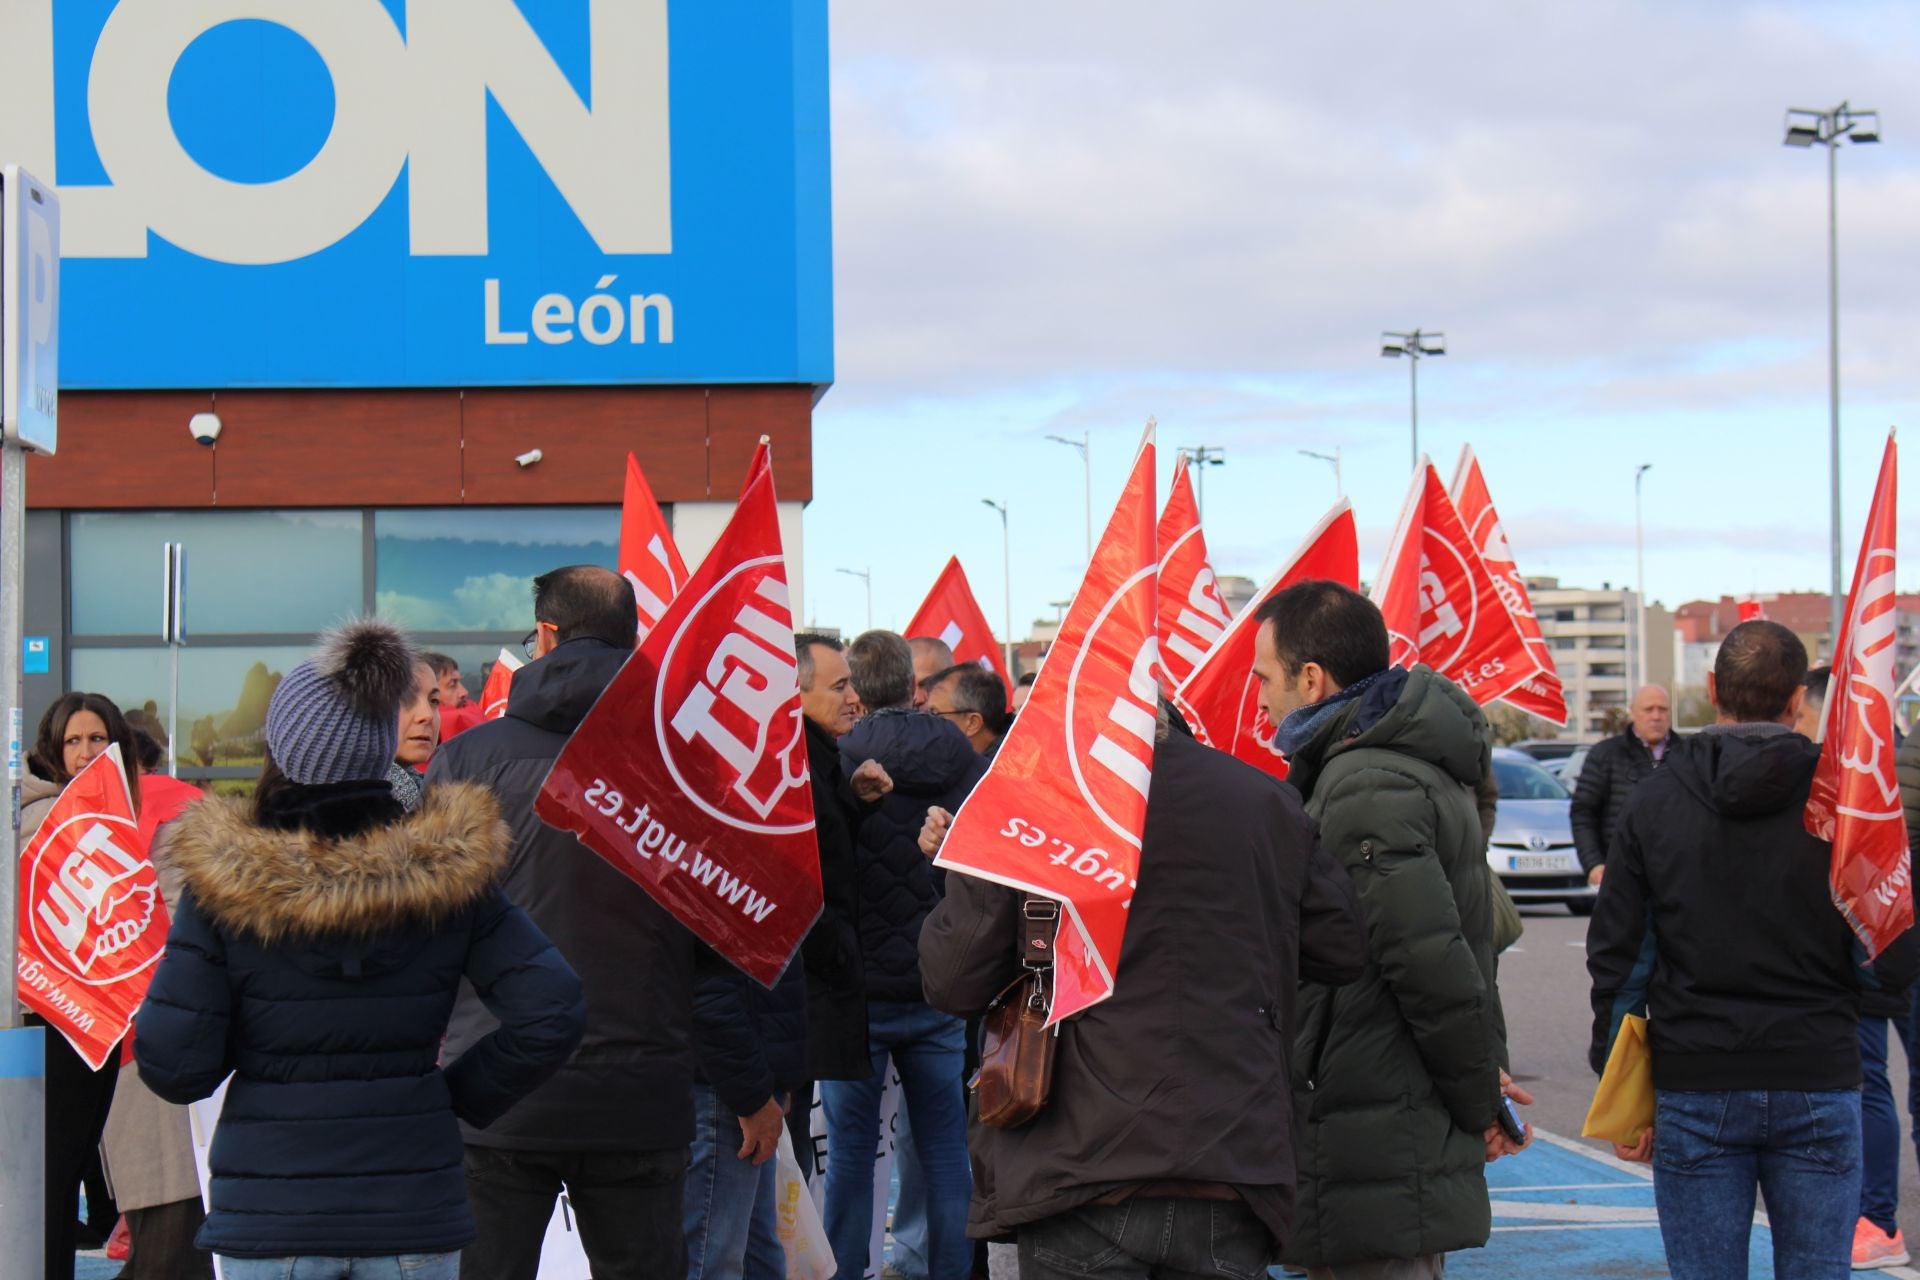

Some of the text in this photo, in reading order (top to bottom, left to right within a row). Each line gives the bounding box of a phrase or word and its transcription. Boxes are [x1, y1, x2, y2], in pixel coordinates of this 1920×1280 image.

[484, 274, 675, 346] León
[1419, 552, 1464, 649] GT
[37, 822, 140, 952] UGT
